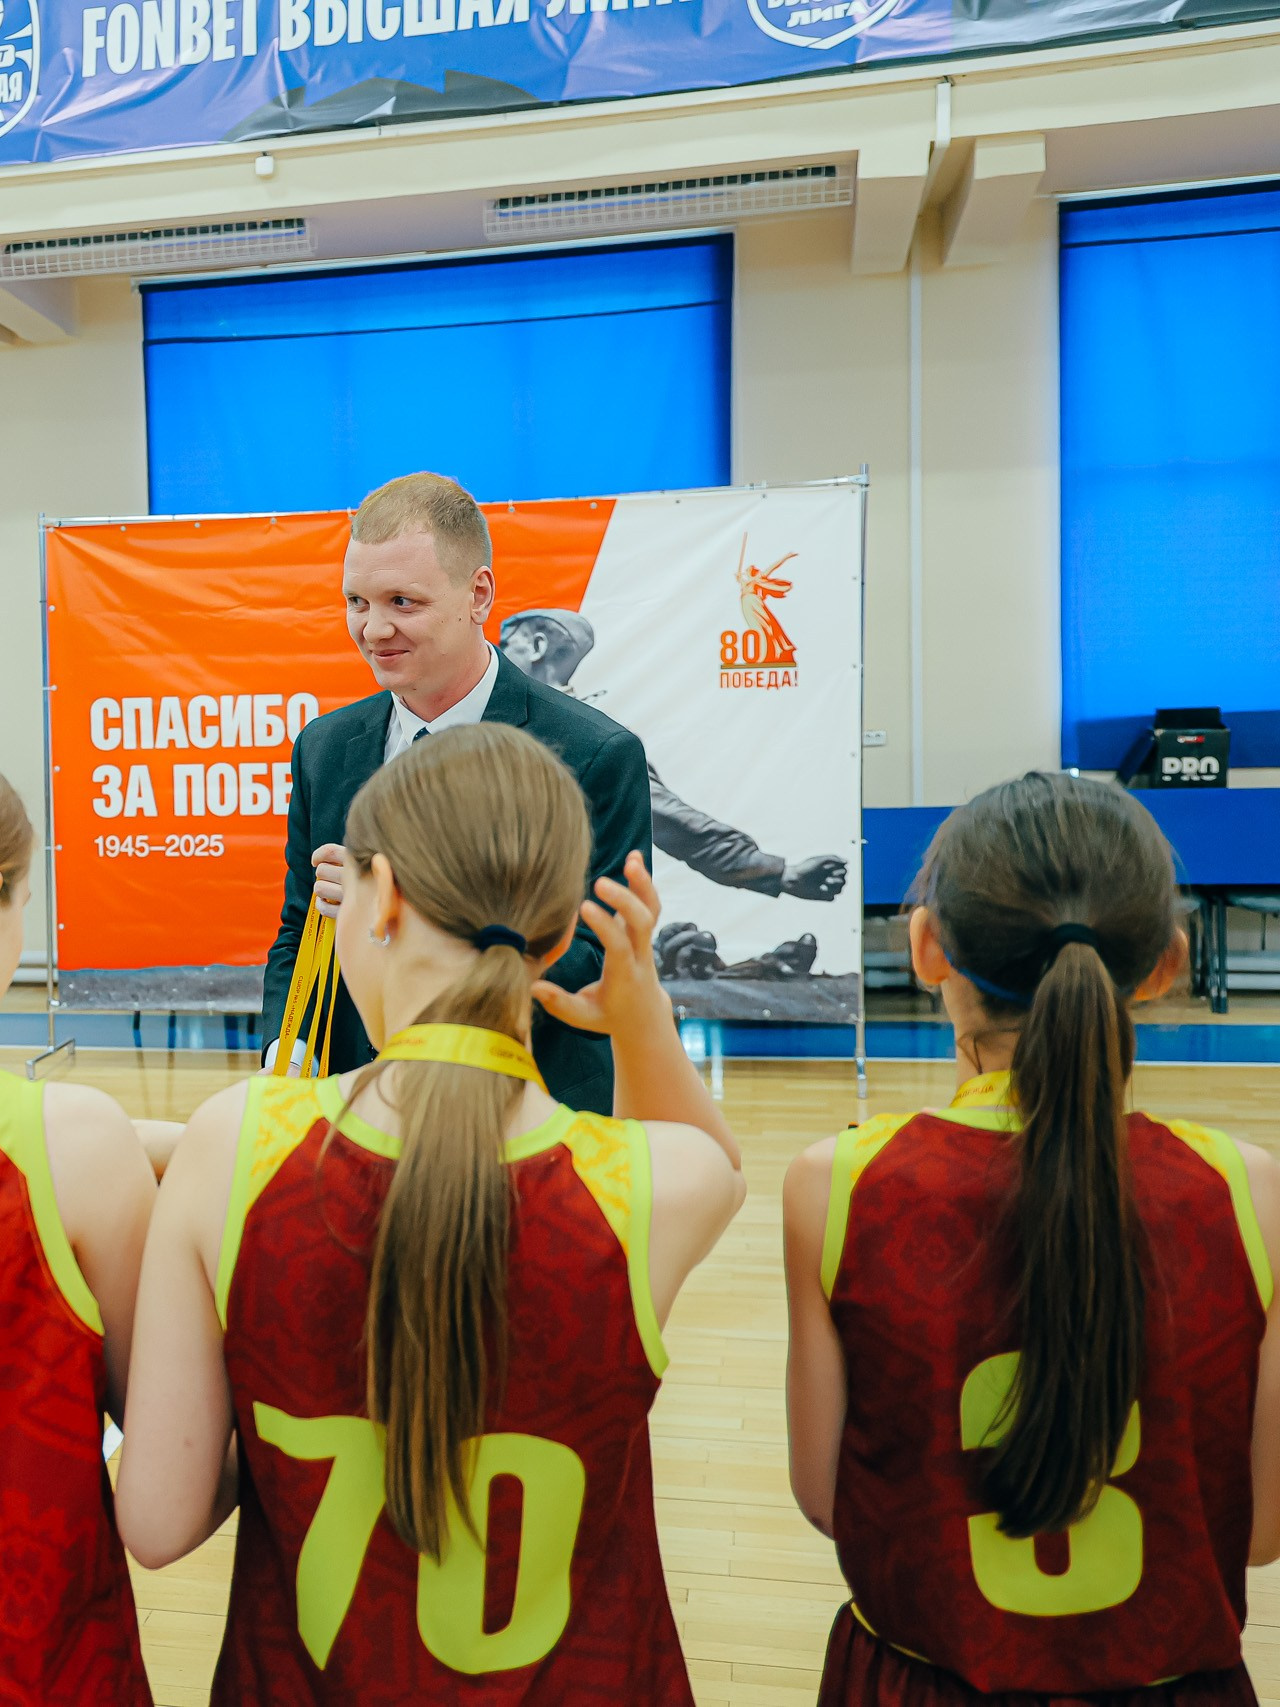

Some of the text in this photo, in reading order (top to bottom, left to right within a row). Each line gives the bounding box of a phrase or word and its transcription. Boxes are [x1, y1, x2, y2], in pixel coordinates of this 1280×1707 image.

[81, 0, 258, 78] FONBET
[787, 1, 868, 28] ЛИГА
[720, 629, 761, 664] 80
[720, 670, 798, 690] ПОБЕДА!
[90, 692, 319, 751] СПАСИБО
[92, 764, 158, 818] ЗА
[252, 1400, 587, 1676] 70
